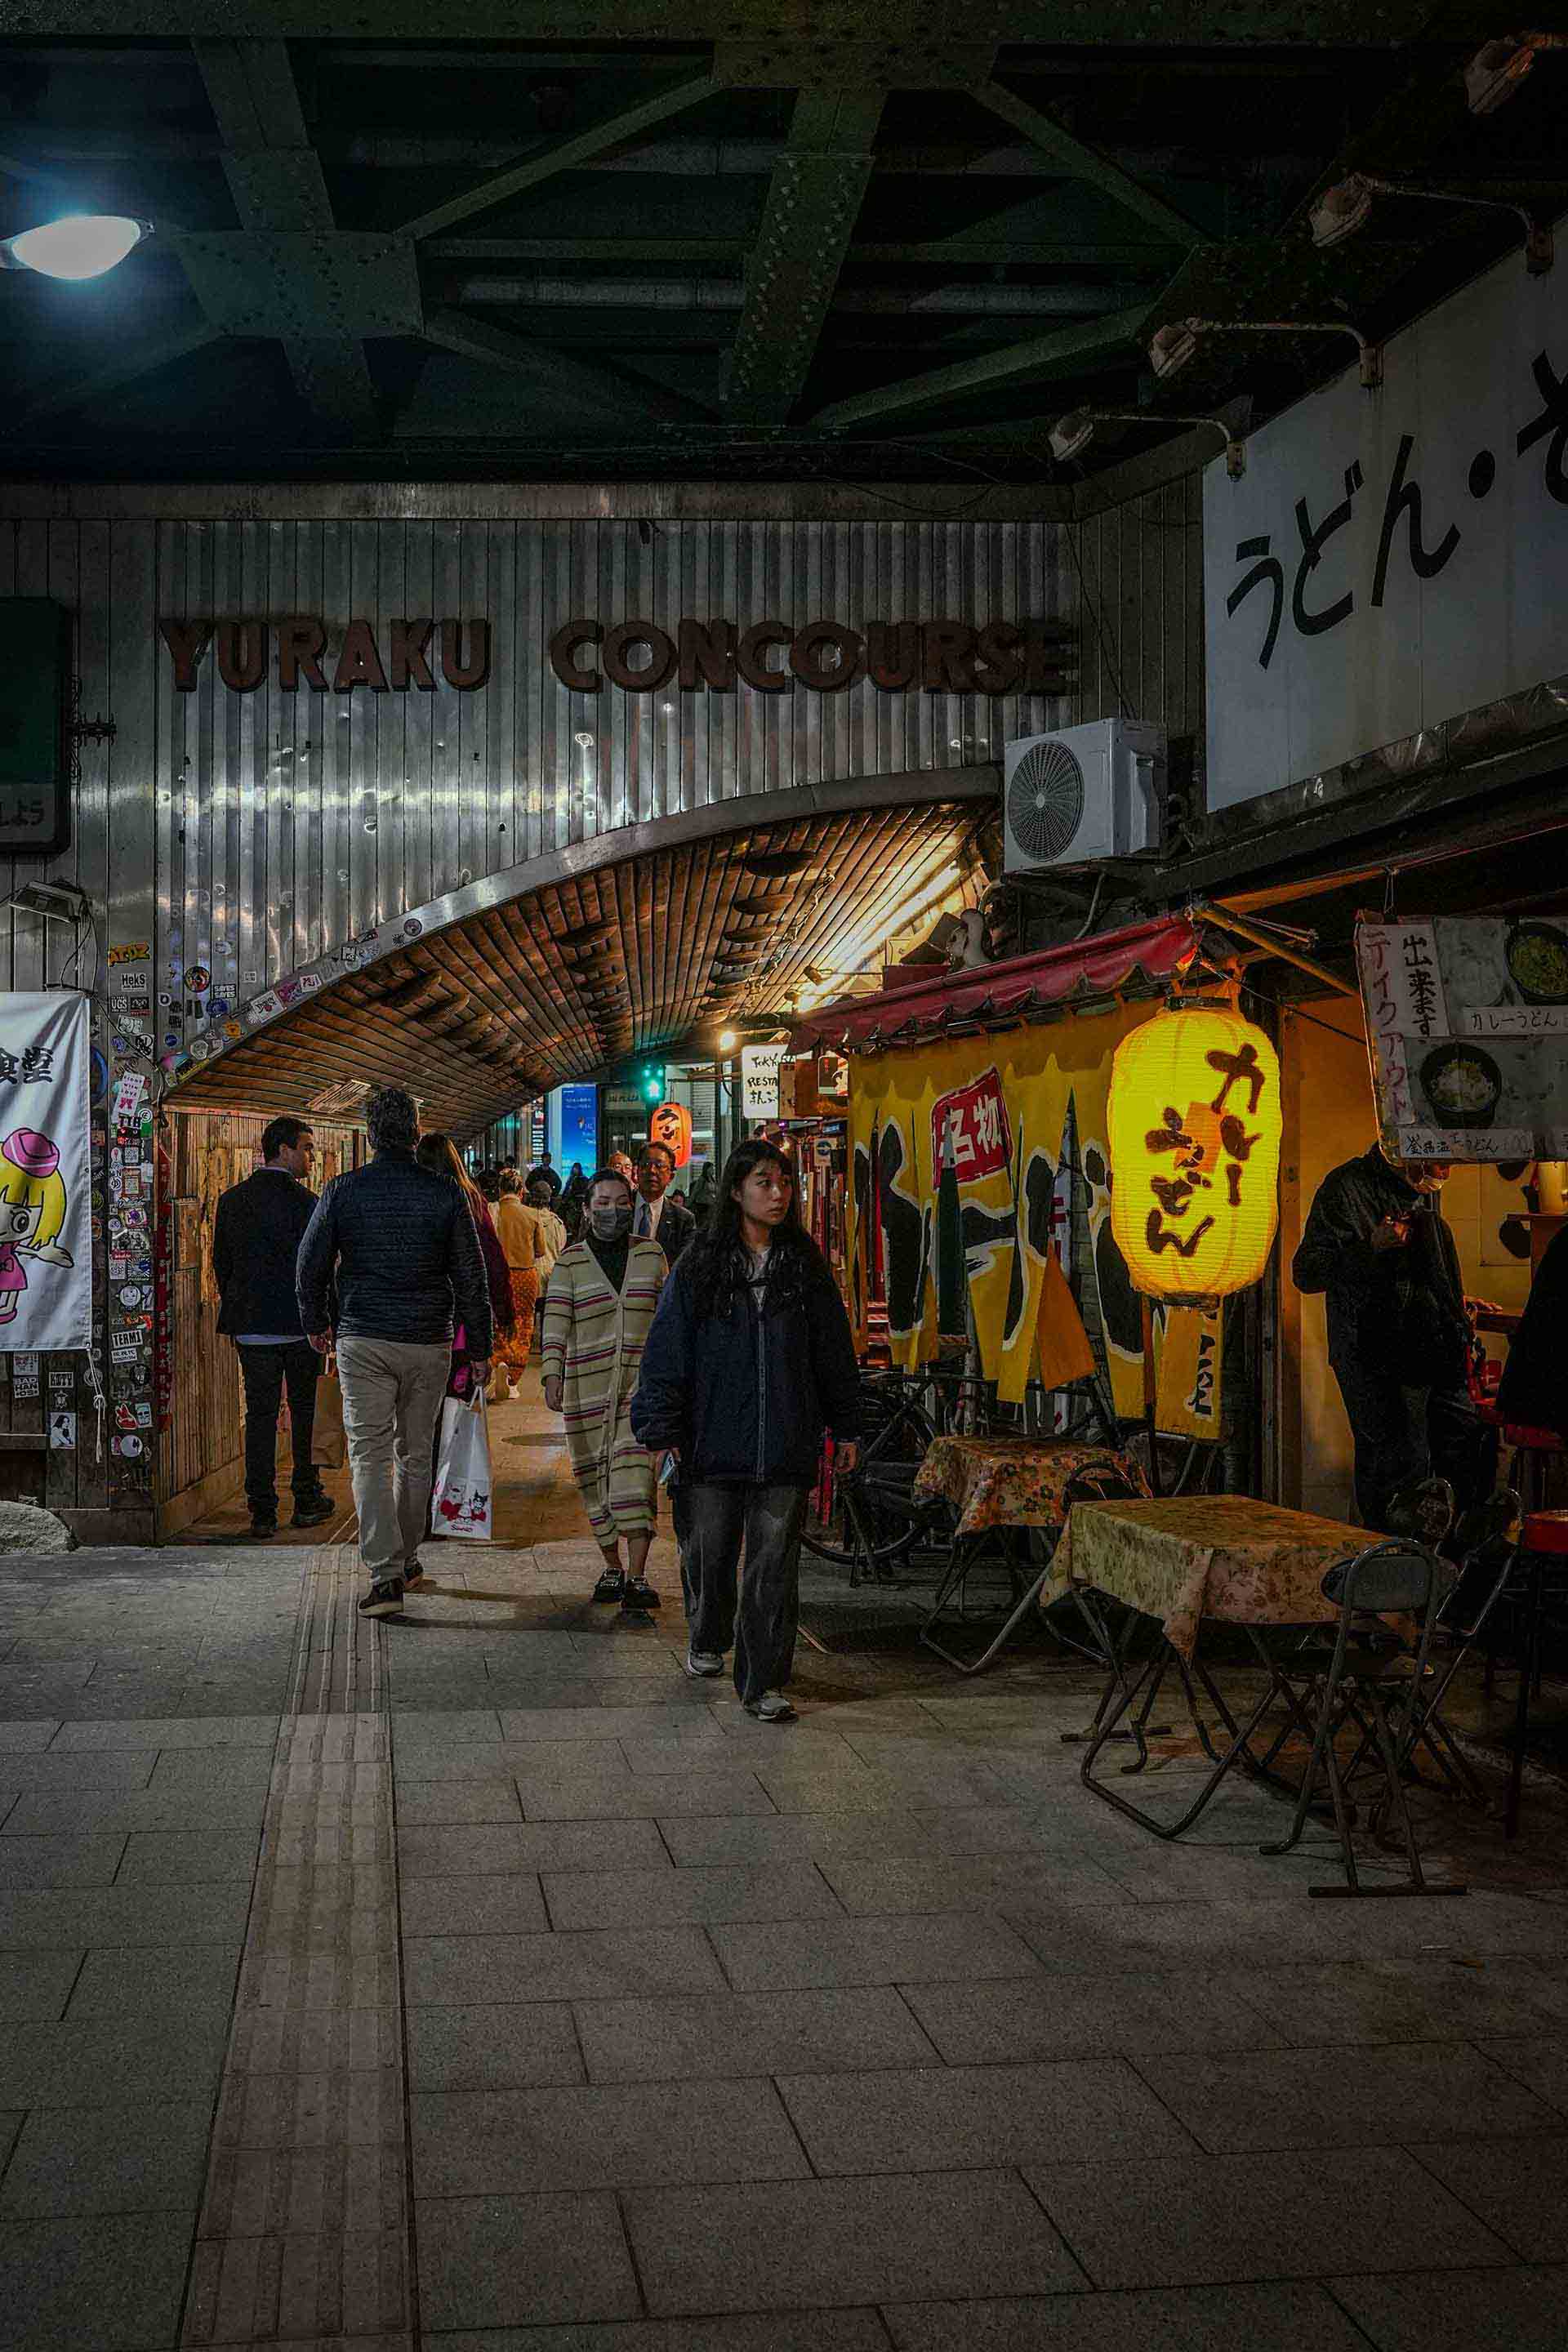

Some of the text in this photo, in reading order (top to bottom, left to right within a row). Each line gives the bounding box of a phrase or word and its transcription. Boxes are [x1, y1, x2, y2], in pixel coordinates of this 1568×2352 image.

[160, 618, 1079, 697] YURAKU CONCOURSE
[1363, 929, 1406, 1118] テイクアウト
[1402, 933, 1437, 1038] 出来ます
[1145, 1107, 1216, 1258] うどん
[1205, 1043, 1265, 1207] カレー
